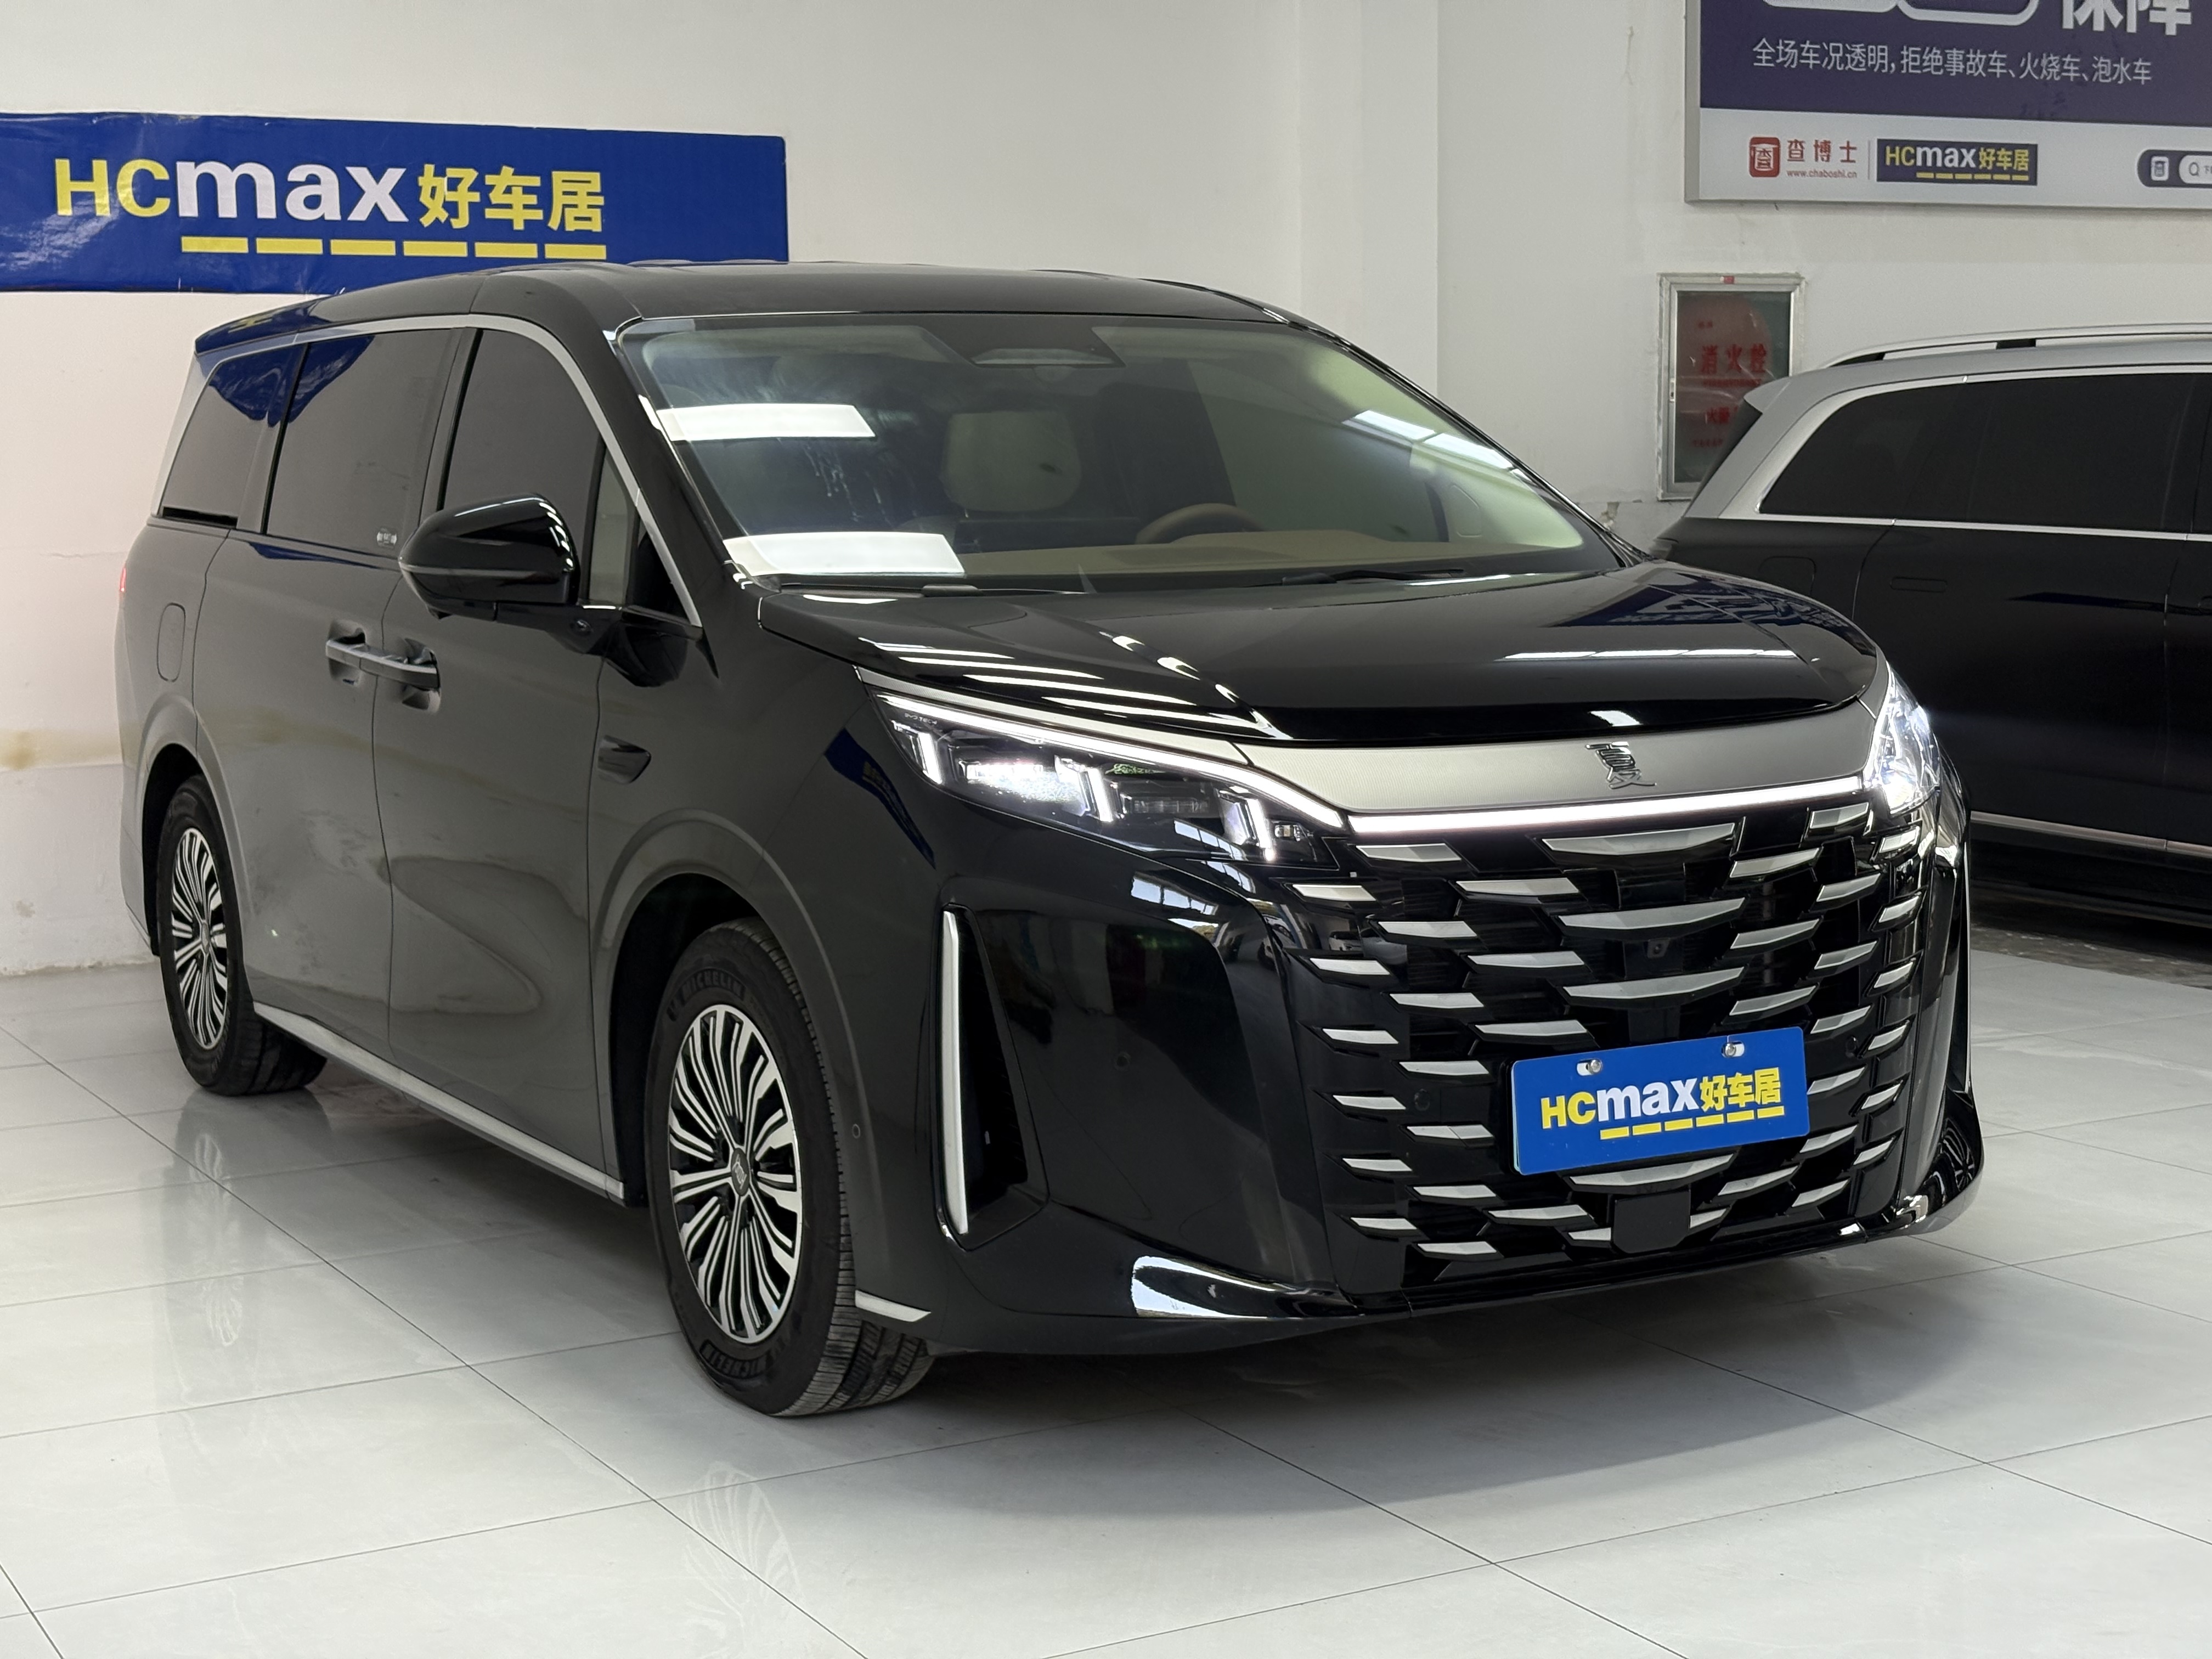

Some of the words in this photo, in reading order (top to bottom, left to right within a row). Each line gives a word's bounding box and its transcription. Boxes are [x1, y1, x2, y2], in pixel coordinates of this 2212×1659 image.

[1787, 139, 1858, 163] 查博士
[1786, 168, 1858, 179] www.chaboshi.cn
[682, 970, 743, 1000] MICHELIN
